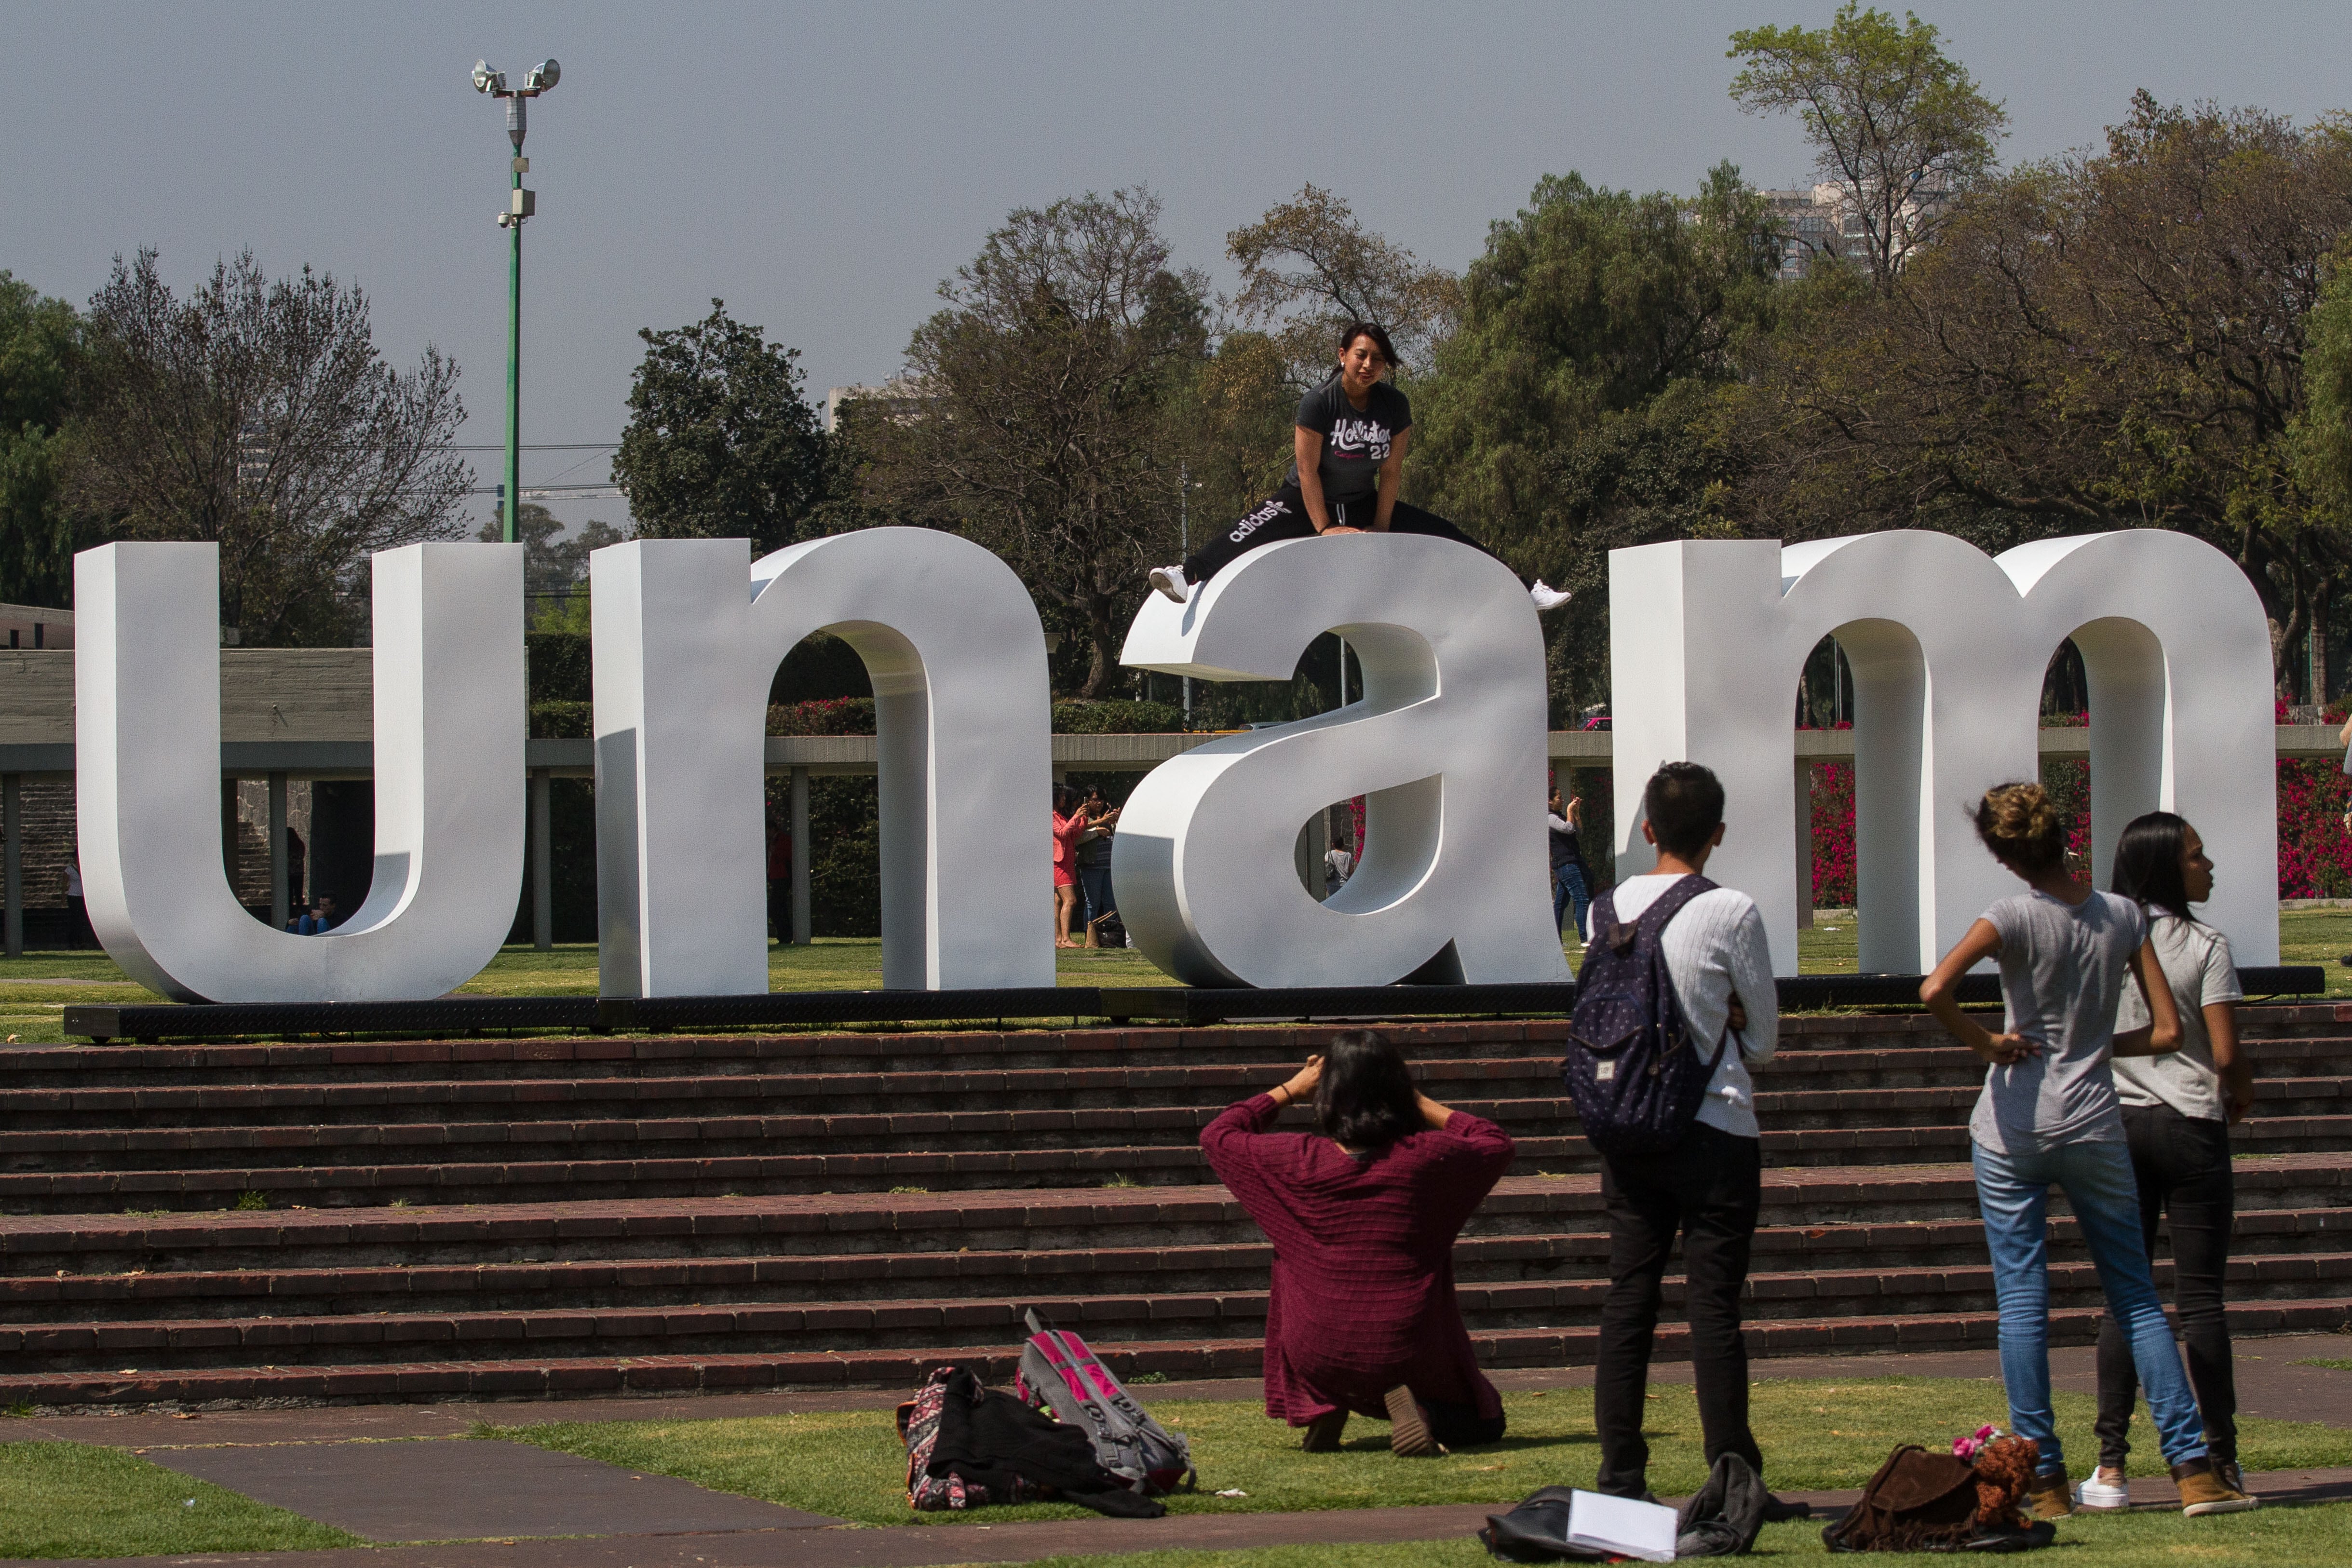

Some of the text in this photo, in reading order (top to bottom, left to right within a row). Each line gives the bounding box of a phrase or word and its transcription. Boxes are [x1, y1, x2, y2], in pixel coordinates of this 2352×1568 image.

[1330, 419, 1391, 450] Hollister
[1370, 443, 1390, 459] 22
[1229, 507, 1278, 542] adidas
[74, 527, 2281, 1006] unam
